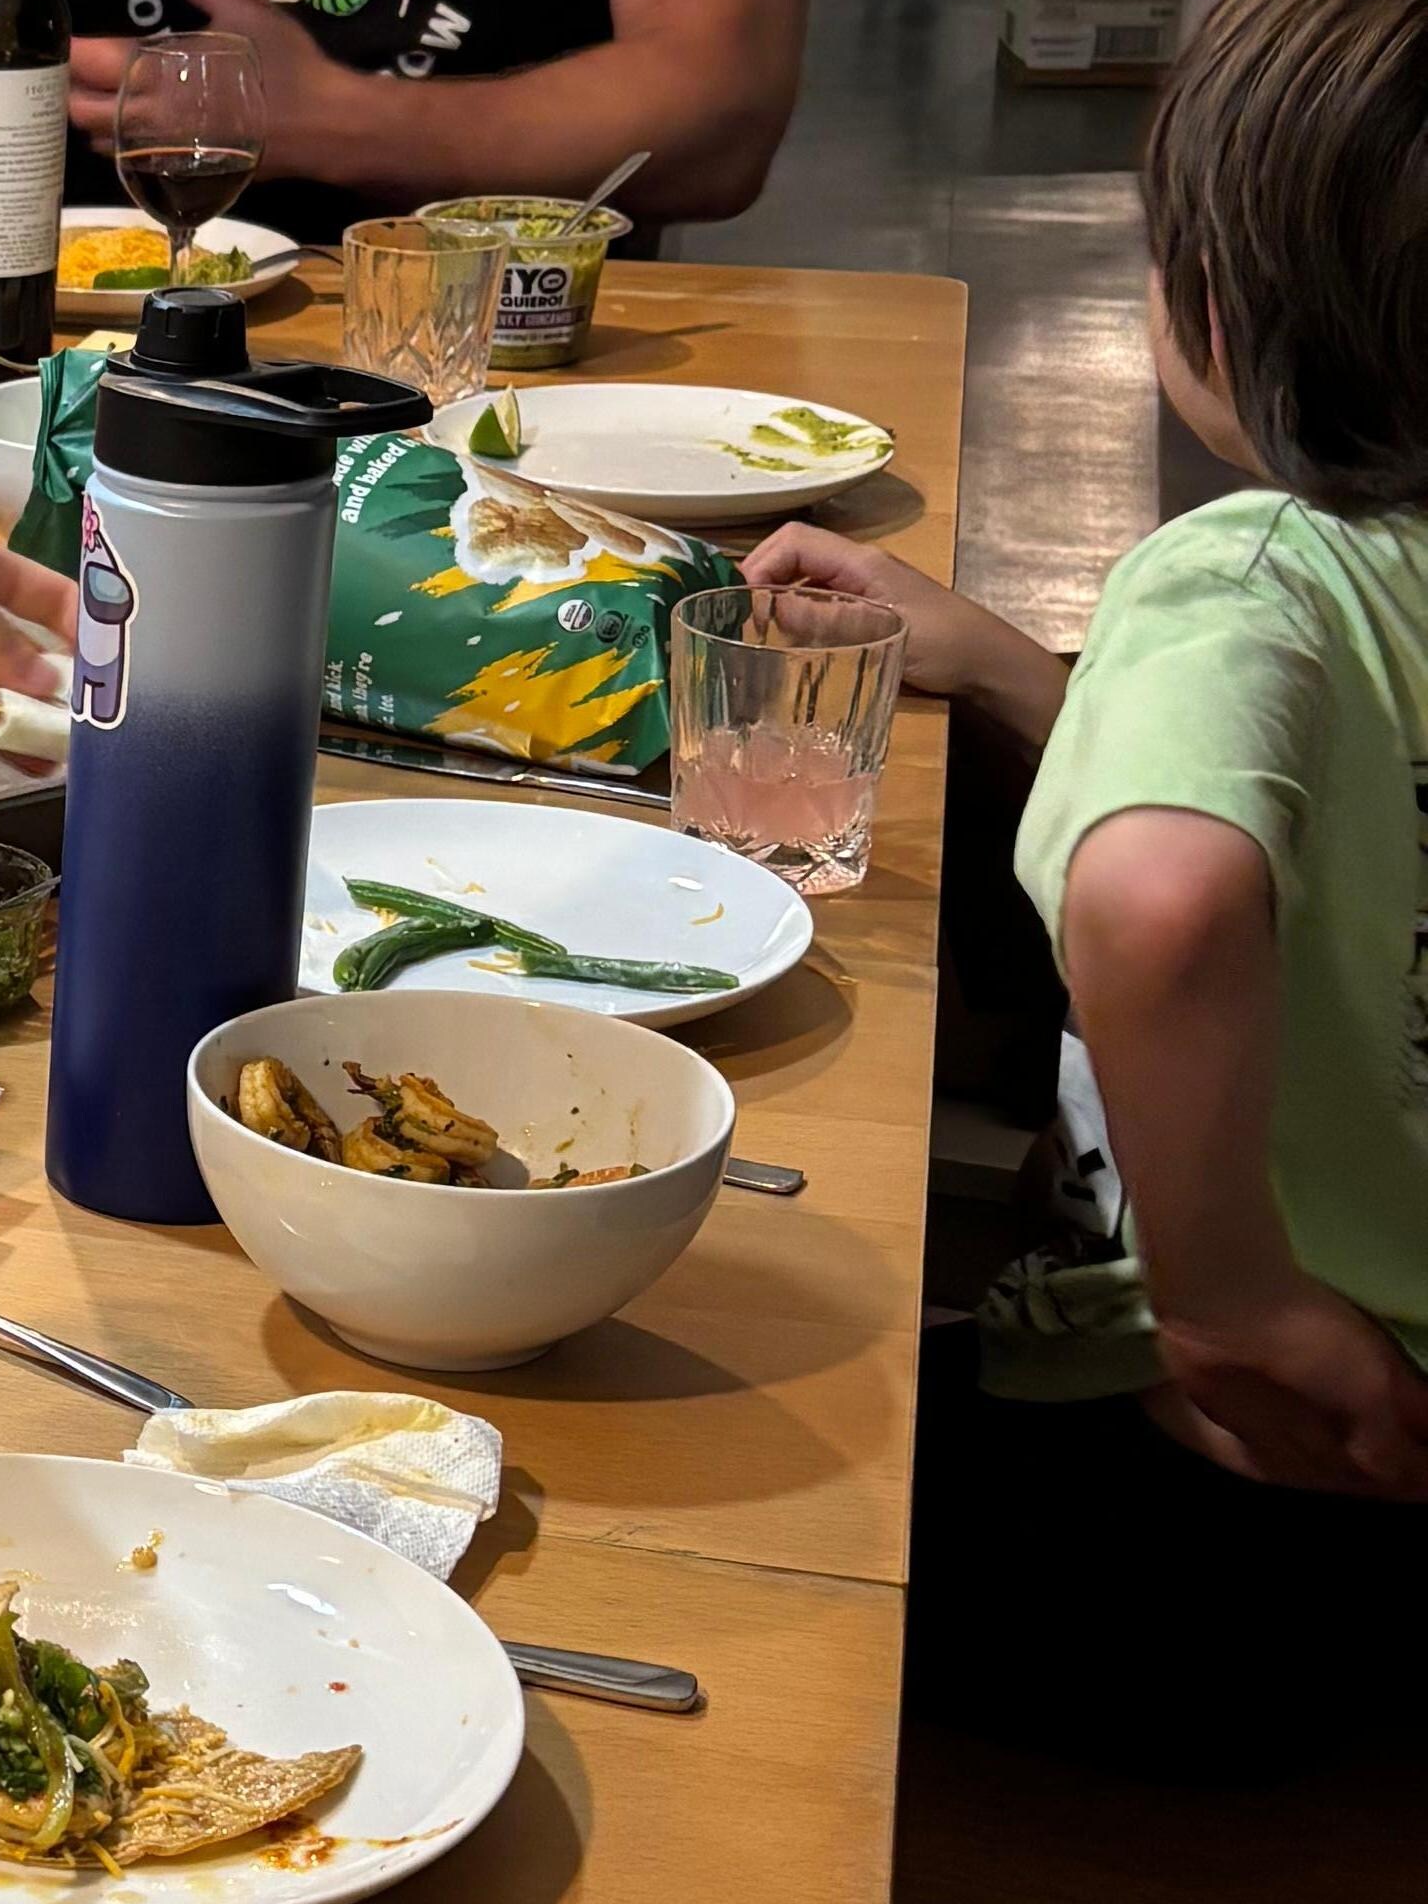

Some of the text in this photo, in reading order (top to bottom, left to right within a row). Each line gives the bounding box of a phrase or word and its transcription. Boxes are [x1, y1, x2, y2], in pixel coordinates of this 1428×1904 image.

[355, 441, 408, 486] baked
[341, 482, 372, 524] and
[351, 651, 373, 701] they're
